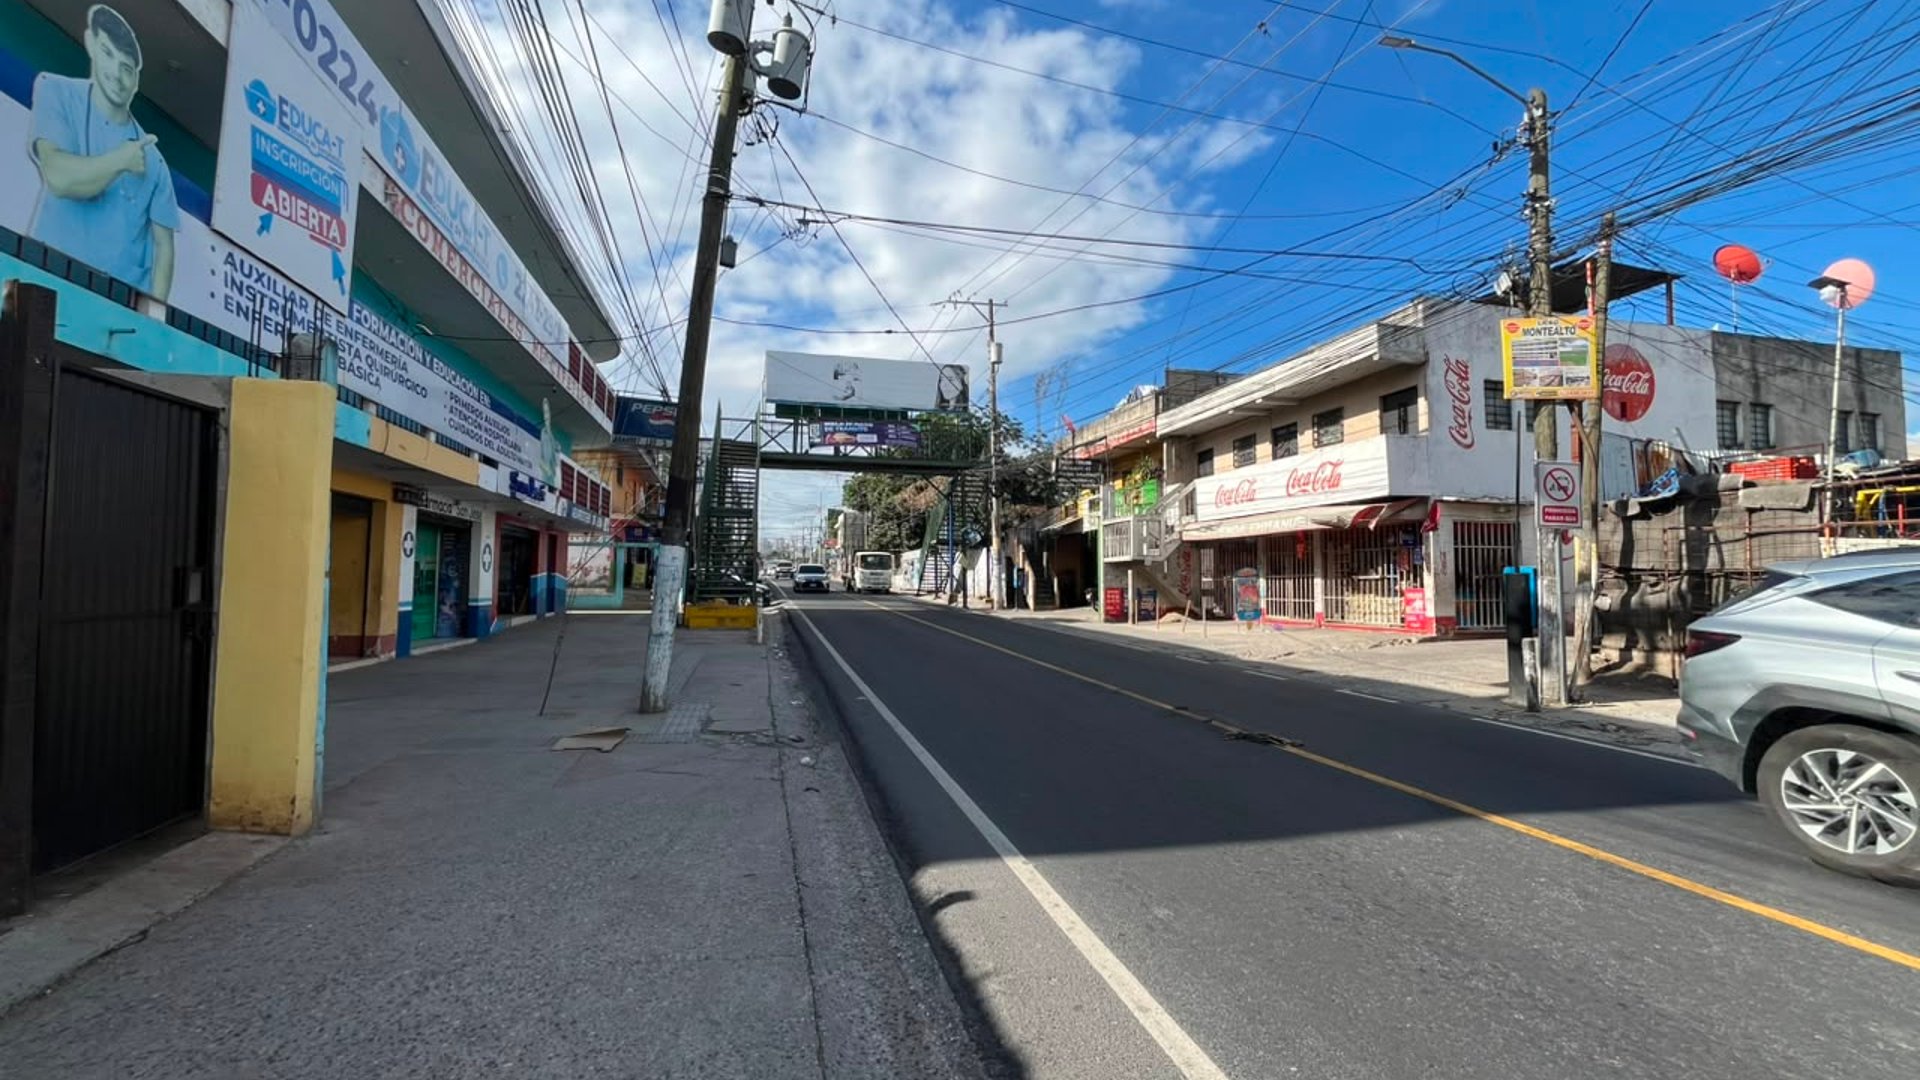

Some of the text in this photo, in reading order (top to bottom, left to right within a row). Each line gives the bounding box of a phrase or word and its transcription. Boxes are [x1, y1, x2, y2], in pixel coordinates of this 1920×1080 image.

[284, 0, 379, 127] 0224
[278, 95, 344, 158] EDUCA-T
[262, 183, 342, 244] ABIERTA
[223, 251, 309, 314] AUXILIAR
[1521, 326, 1577, 336] MONTEALTO
[631, 402, 678, 418] PEPSI
